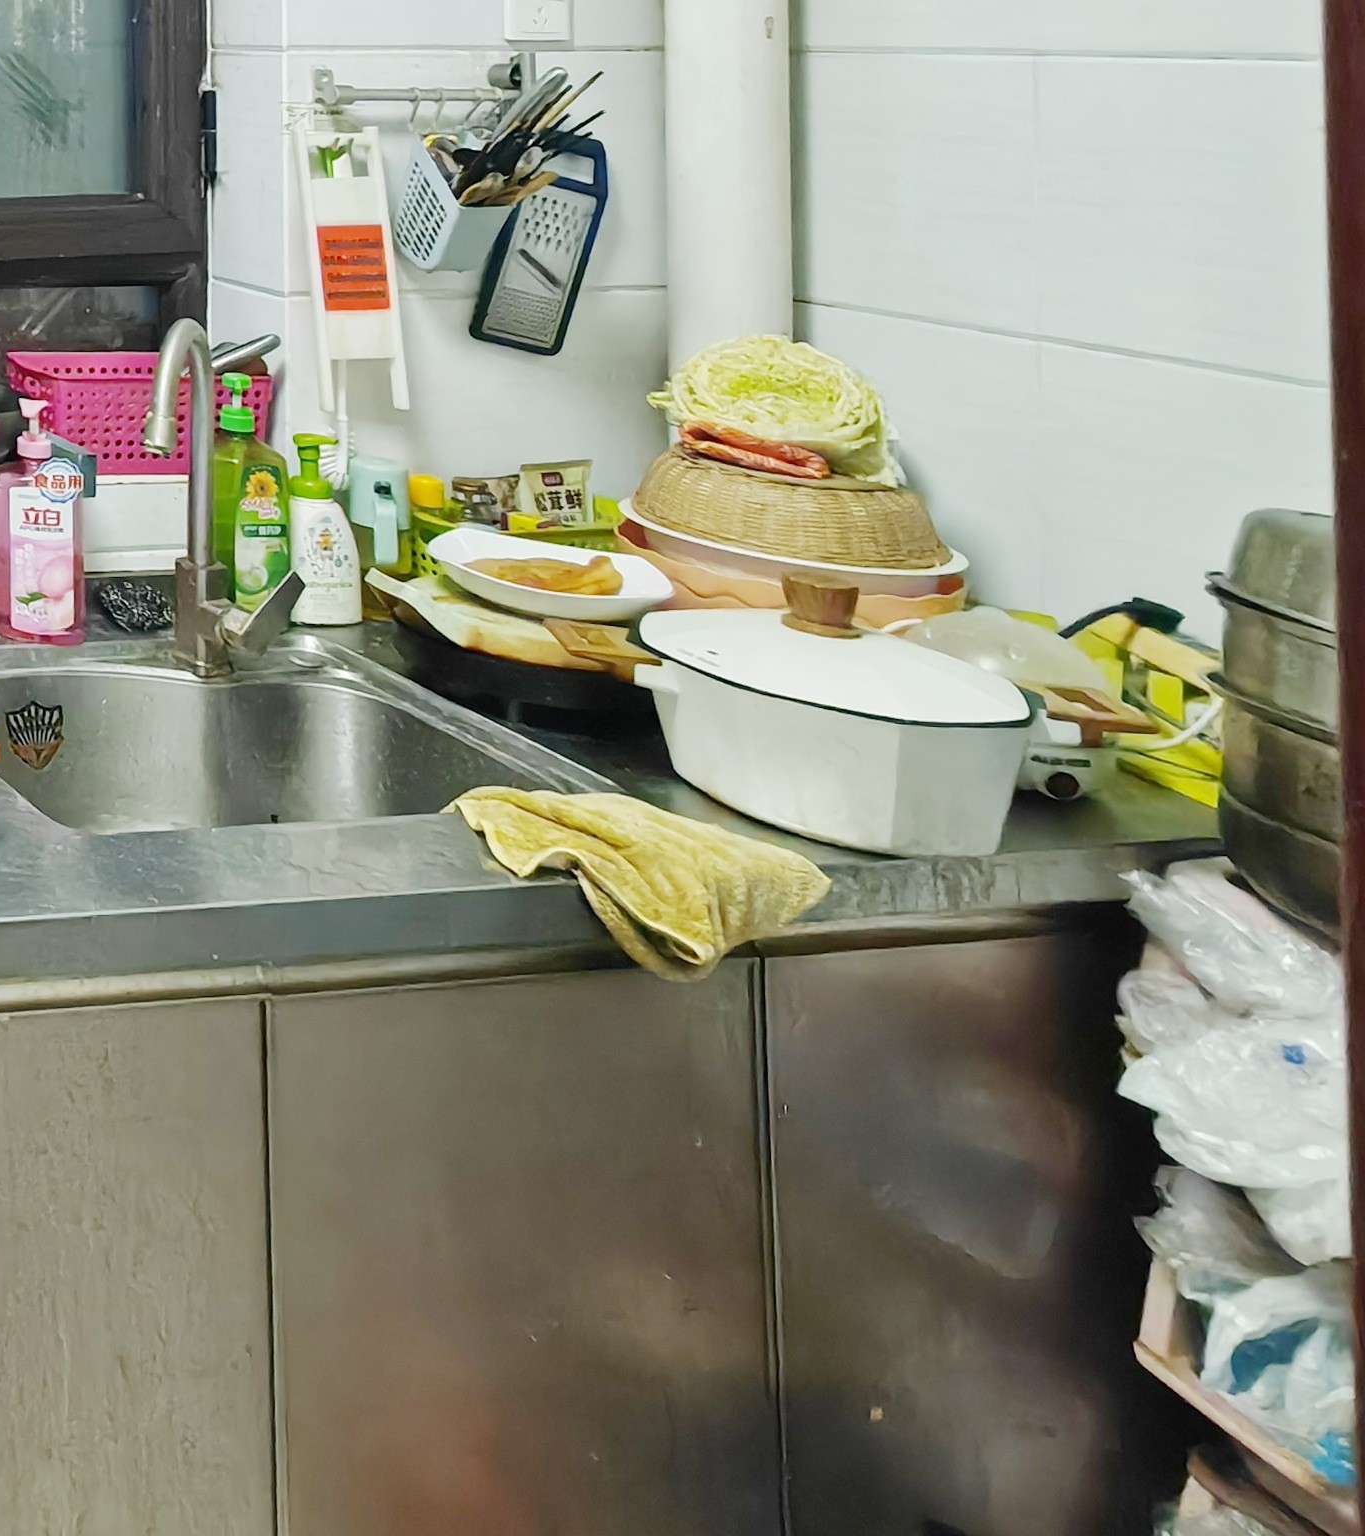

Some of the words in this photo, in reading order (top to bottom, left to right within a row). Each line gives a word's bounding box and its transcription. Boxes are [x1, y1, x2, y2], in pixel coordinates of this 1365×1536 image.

[34, 474, 82, 490] 食品用
[22, 508, 61, 526] 立白
